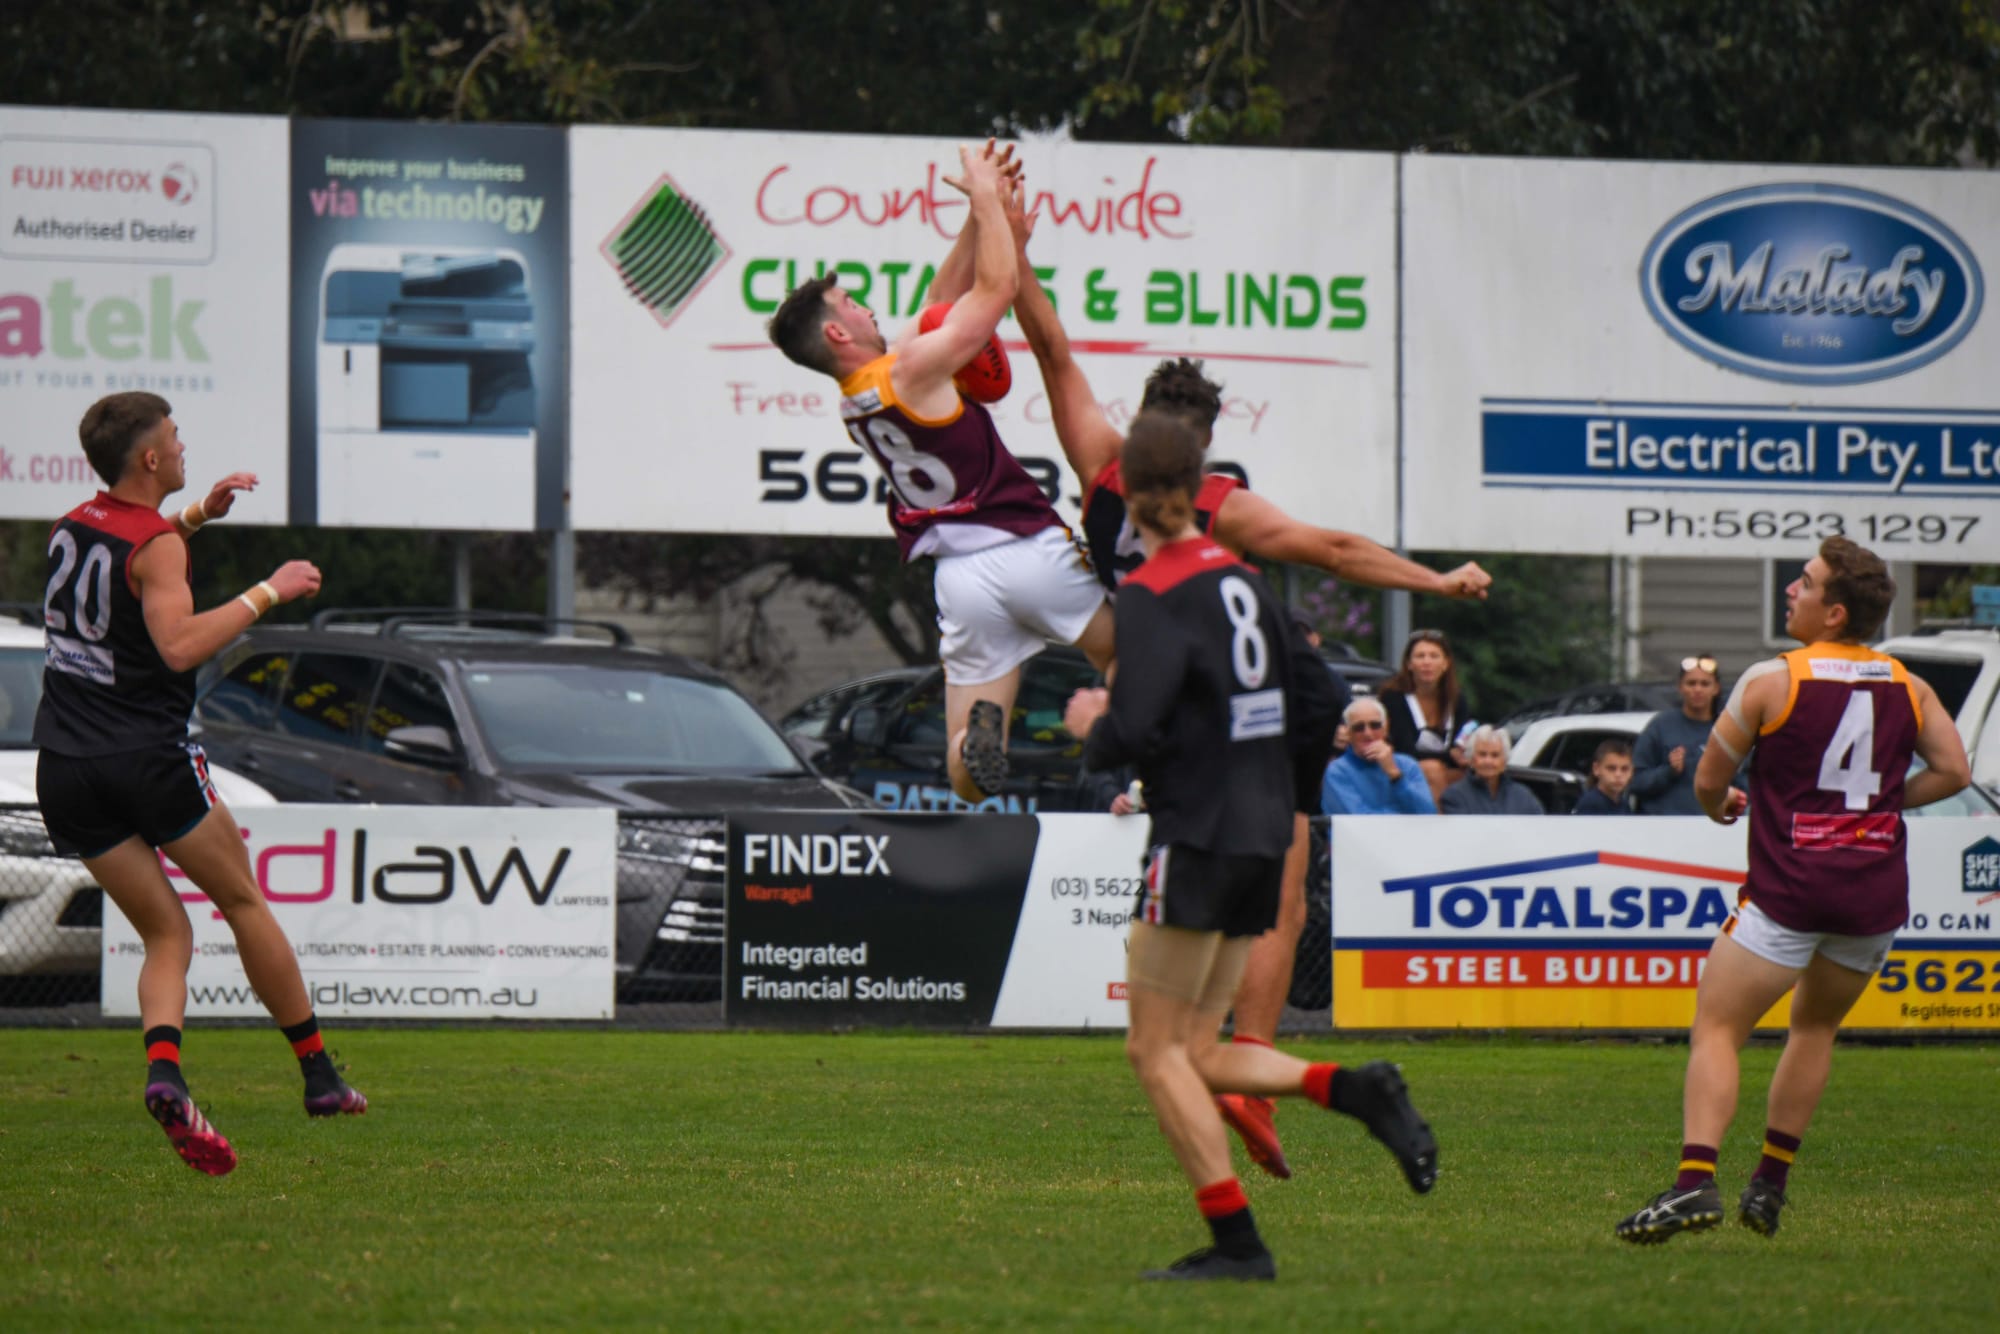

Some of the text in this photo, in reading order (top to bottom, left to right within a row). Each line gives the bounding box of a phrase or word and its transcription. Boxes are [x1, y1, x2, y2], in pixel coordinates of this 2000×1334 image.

[12, 166, 152, 193] FUJI xerox
[325, 155, 525, 182] Improve your business
[310, 180, 544, 233] via technology
[756, 157, 1193, 239] Countwide
[13, 216, 197, 243] Authorised Dealer
[1084, 268, 1118, 322] &
[1146, 269, 1367, 330] BLINDS
[1678, 242, 1944, 335] Malady
[37, 373, 94, 388] YOUR
[105, 374, 215, 391] BUSINESS
[726, 381, 829, 417] Free
[848, 417, 957, 510] 18
[1586, 421, 1816, 473] Electrical
[1838, 427, 1924, 493] Pty.
[1860, 514, 1981, 543] 1297
[44, 528, 112, 641] 20
[1219, 575, 1268, 690] 8
[1817, 690, 1881, 811] 4
[744, 835, 891, 877] FINDEX
[554, 896, 609, 907] LAWYERS
[744, 883, 813, 905] Warragul
[1051, 877, 1088, 901] (03)
[1071, 908, 1083, 925] 3
[1939, 913, 1990, 930] CAN
[297, 943, 367, 957] LITIGATION
[378, 944, 426, 957] ESTATE
[430, 944, 494, 958] PLANNING
[506, 945, 609, 959] CONVEYANCING
[742, 941, 867, 966] Integrated
[1406, 957, 1527, 984] STEEL
[742, 976, 966, 1000] Financial Solutions
[1900, 1003, 1983, 1021] Registered
